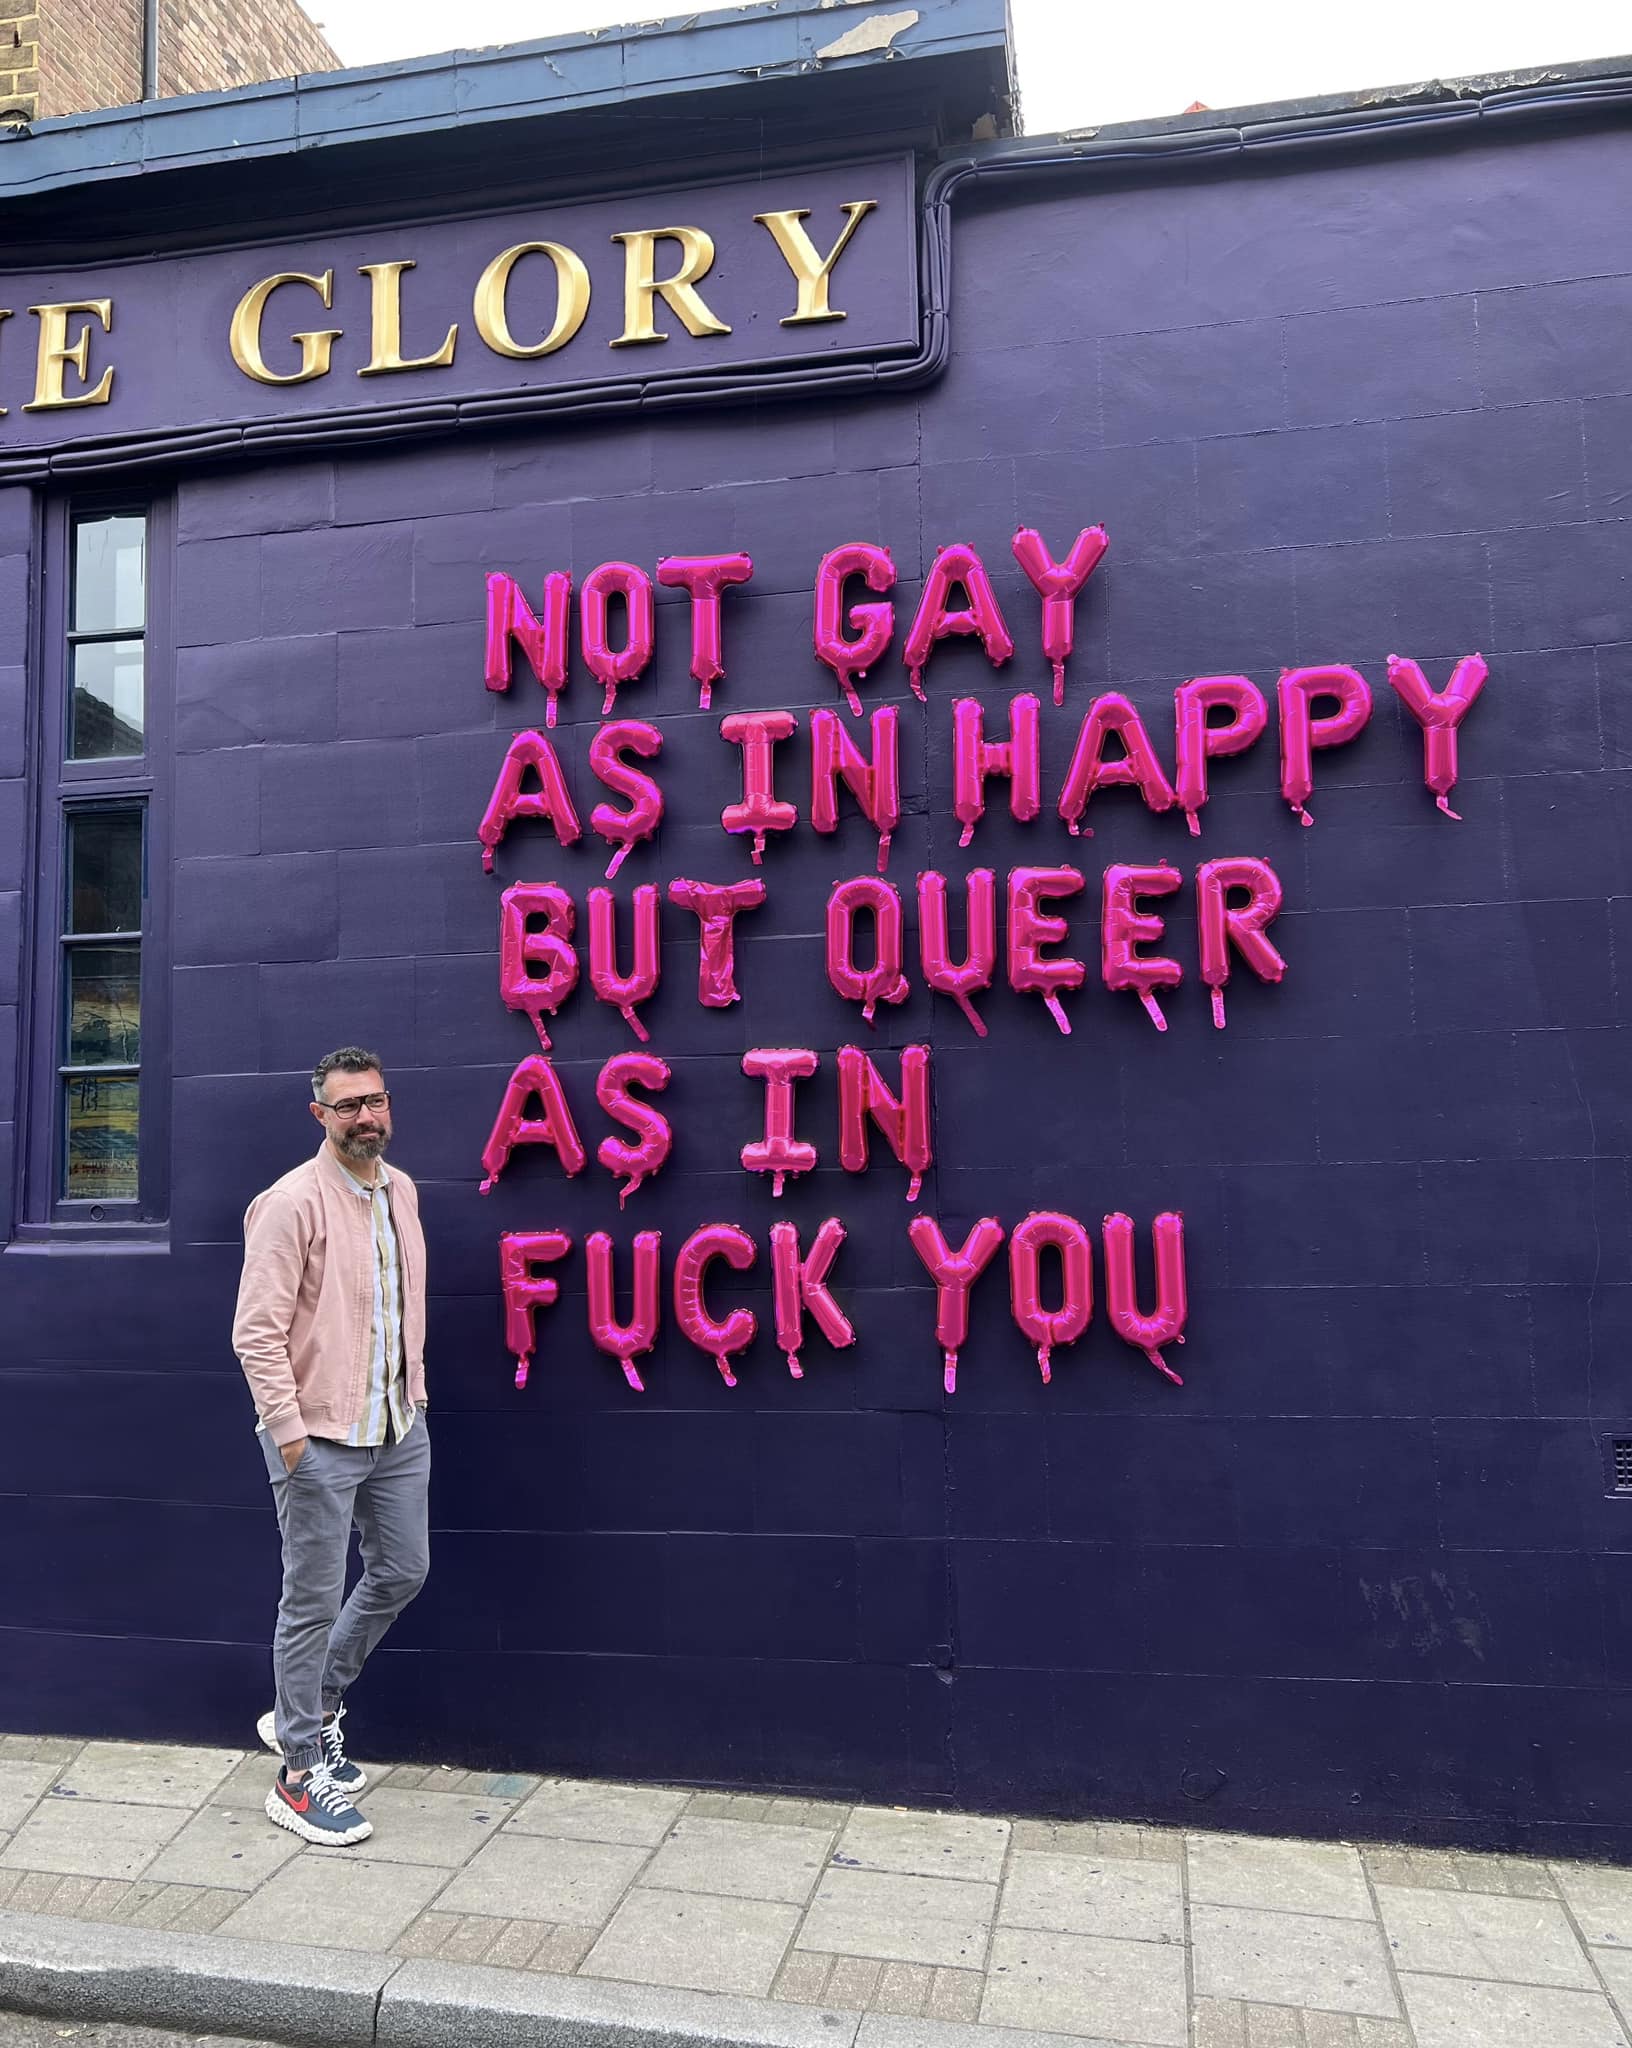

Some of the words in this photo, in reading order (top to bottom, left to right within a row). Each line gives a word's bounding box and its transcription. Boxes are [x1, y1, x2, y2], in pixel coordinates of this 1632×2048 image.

[228, 199, 878, 386] GLORY
[484, 552, 754, 698] NOT
[813, 525, 1109, 676] GAY
[477, 719, 664, 848] AS
[720, 704, 900, 832] IN
[951, 654, 1489, 822] HAPPY
[499, 876, 767, 1012] BUT
[825, 856, 1288, 1006] QUEER
[480, 1051, 674, 1180] AS
[740, 1043, 933, 1175] IN
[499, 1216, 857, 1356] FUCK
[908, 1210, 1190, 1350] YOU
